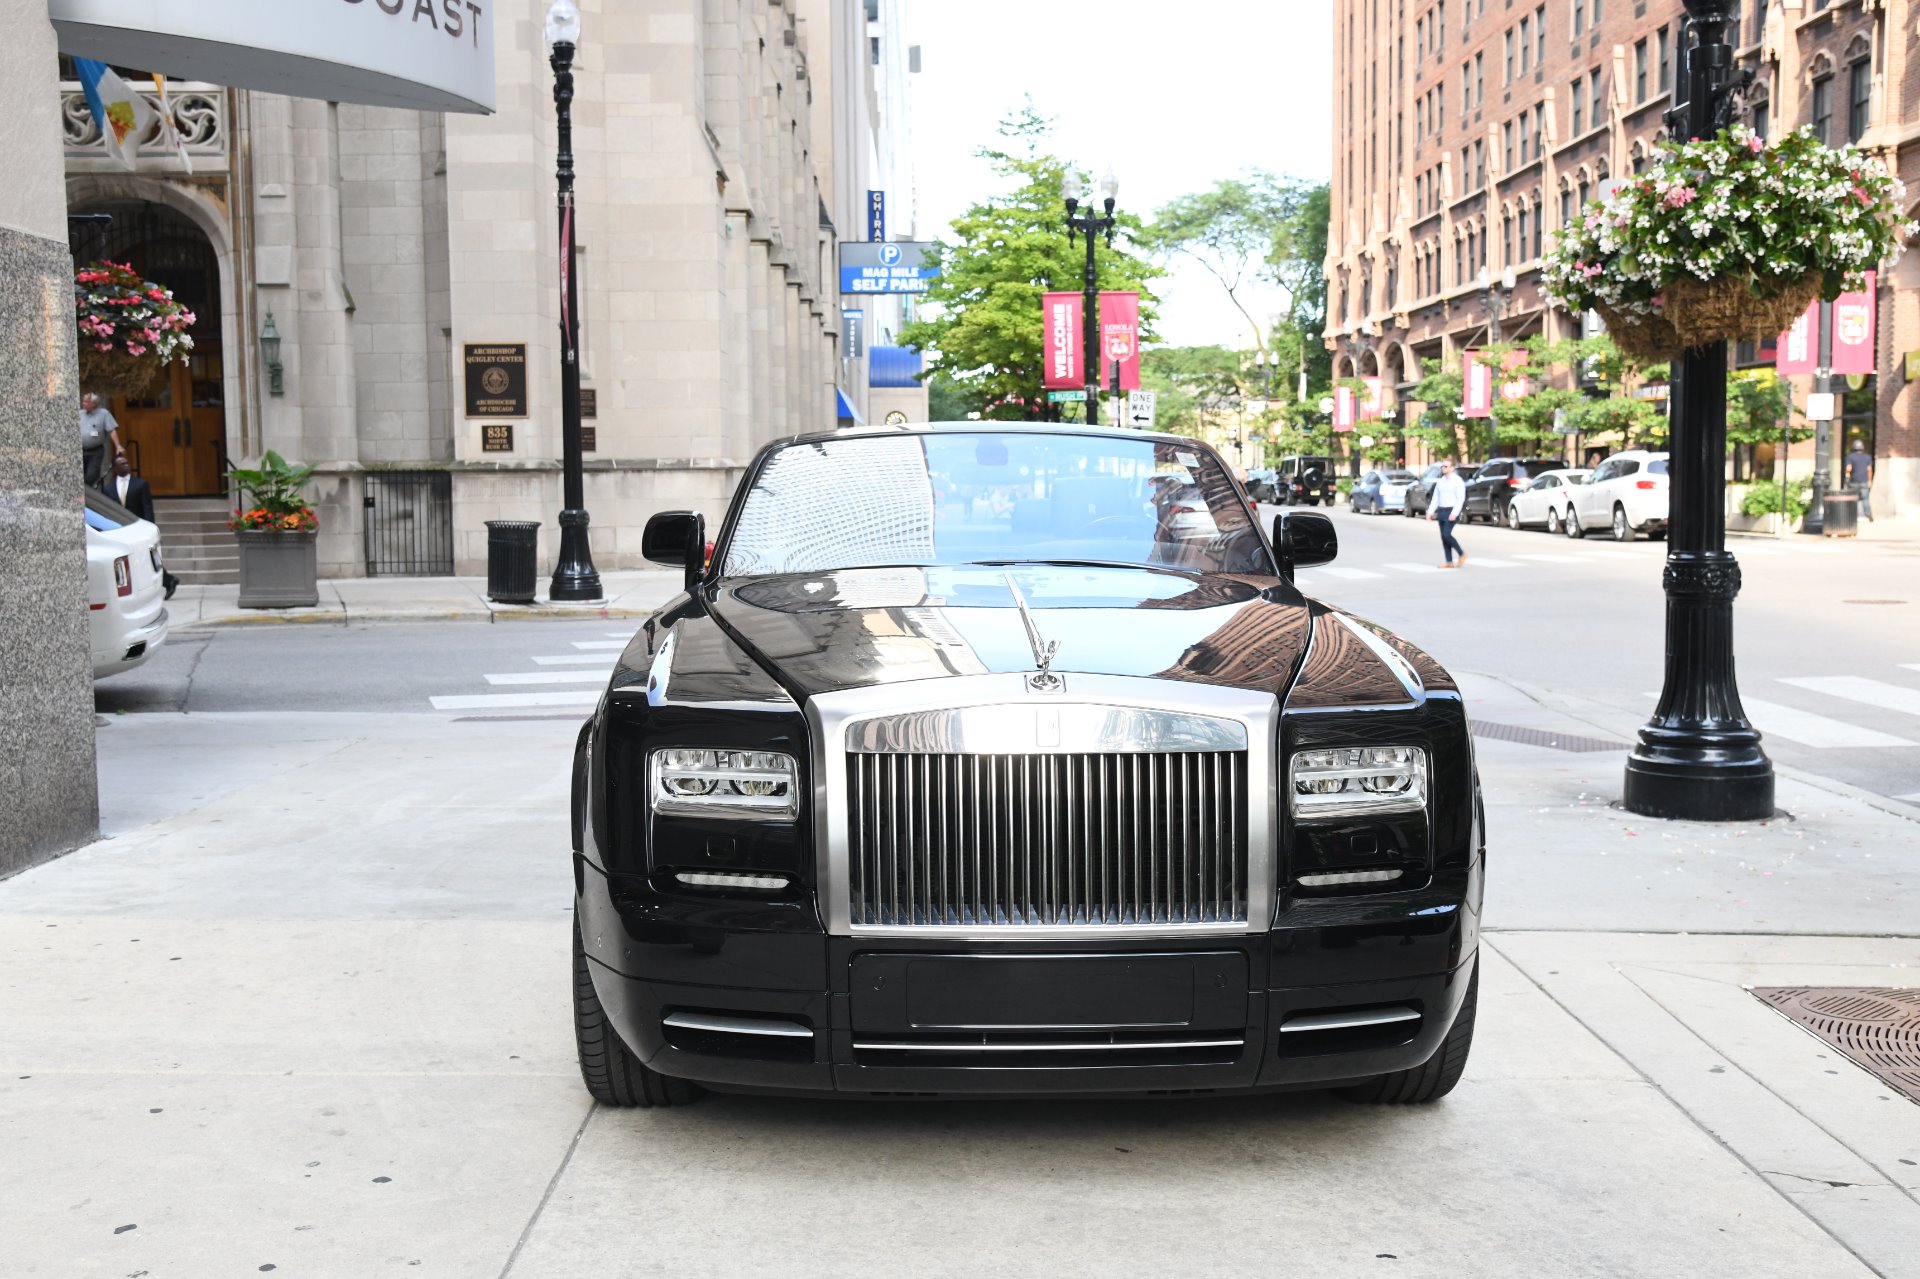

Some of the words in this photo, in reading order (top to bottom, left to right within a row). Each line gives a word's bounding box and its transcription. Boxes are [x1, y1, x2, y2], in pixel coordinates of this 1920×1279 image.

[342, 0, 482, 47] AST
[884, 246, 898, 262] P
[862, 267, 889, 277] MAG
[890, 267, 919, 277] MILE
[852, 279, 887, 291] SELF
[1053, 304, 1067, 378] WELCOME
[1132, 394, 1152, 402] ONE
[1131, 403, 1152, 412] WAY
[487, 427, 508, 438] 835
